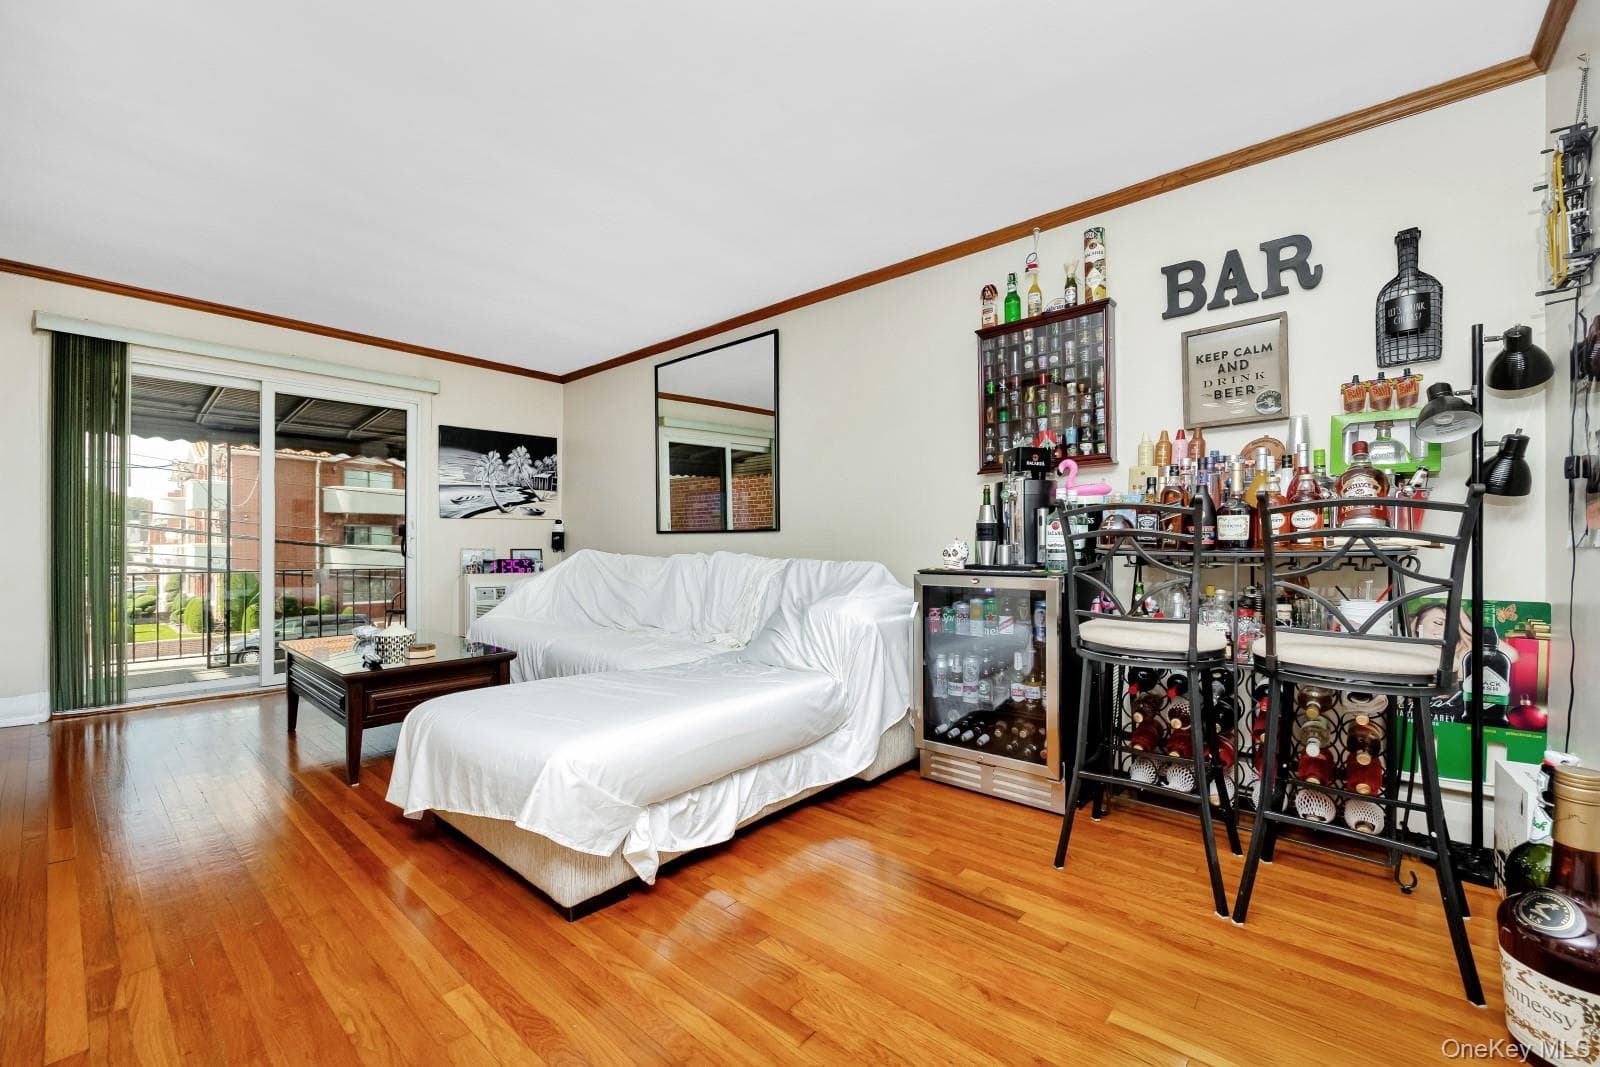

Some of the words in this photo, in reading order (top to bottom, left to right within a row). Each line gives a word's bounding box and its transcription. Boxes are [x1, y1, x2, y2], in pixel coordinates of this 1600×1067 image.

[1161, 234, 1323, 320] BAR
[1195, 350, 1228, 365] KEEP
[1233, 342, 1273, 357] CALM
[1217, 359, 1249, 375] AND
[1202, 371, 1265, 388] DRINK
[1213, 384, 1256, 400] BEER
[1430, 714, 1456, 723] AREY
